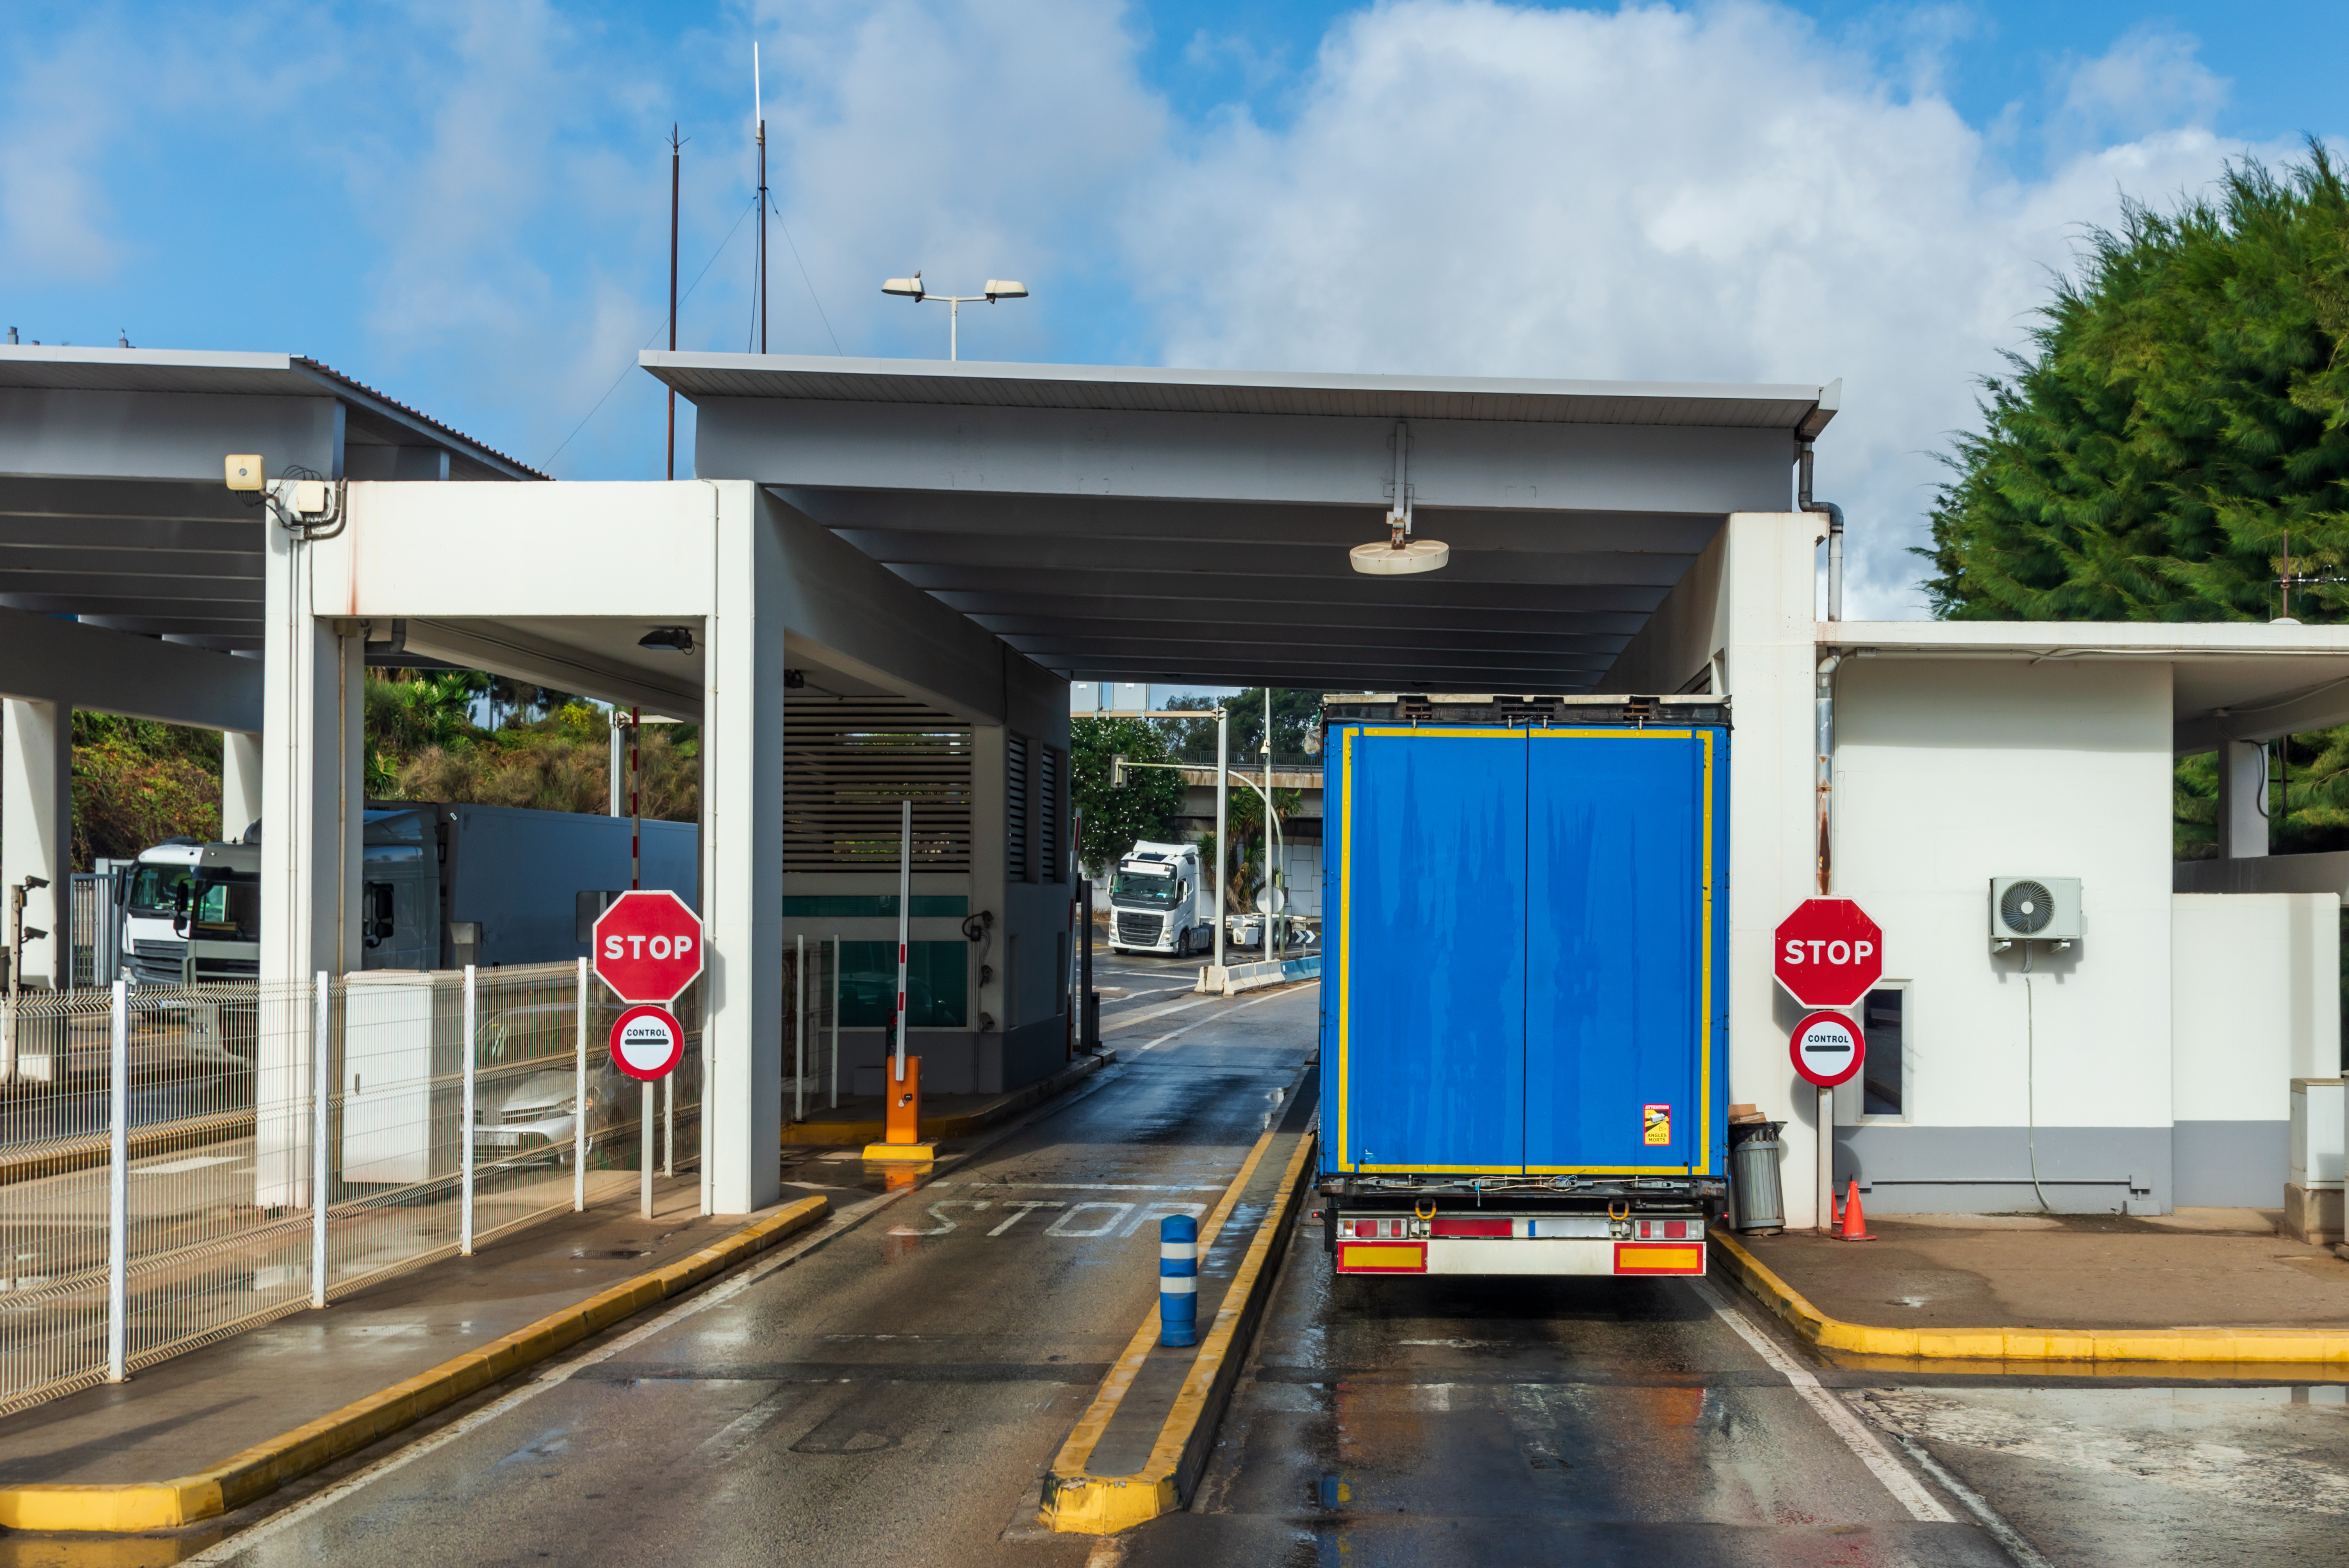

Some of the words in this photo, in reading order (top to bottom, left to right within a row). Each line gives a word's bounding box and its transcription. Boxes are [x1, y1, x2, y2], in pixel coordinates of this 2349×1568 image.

[604, 935, 692, 959] STOP
[1784, 940, 1873, 964] STOP
[885, 1200, 1208, 1237] STOP
